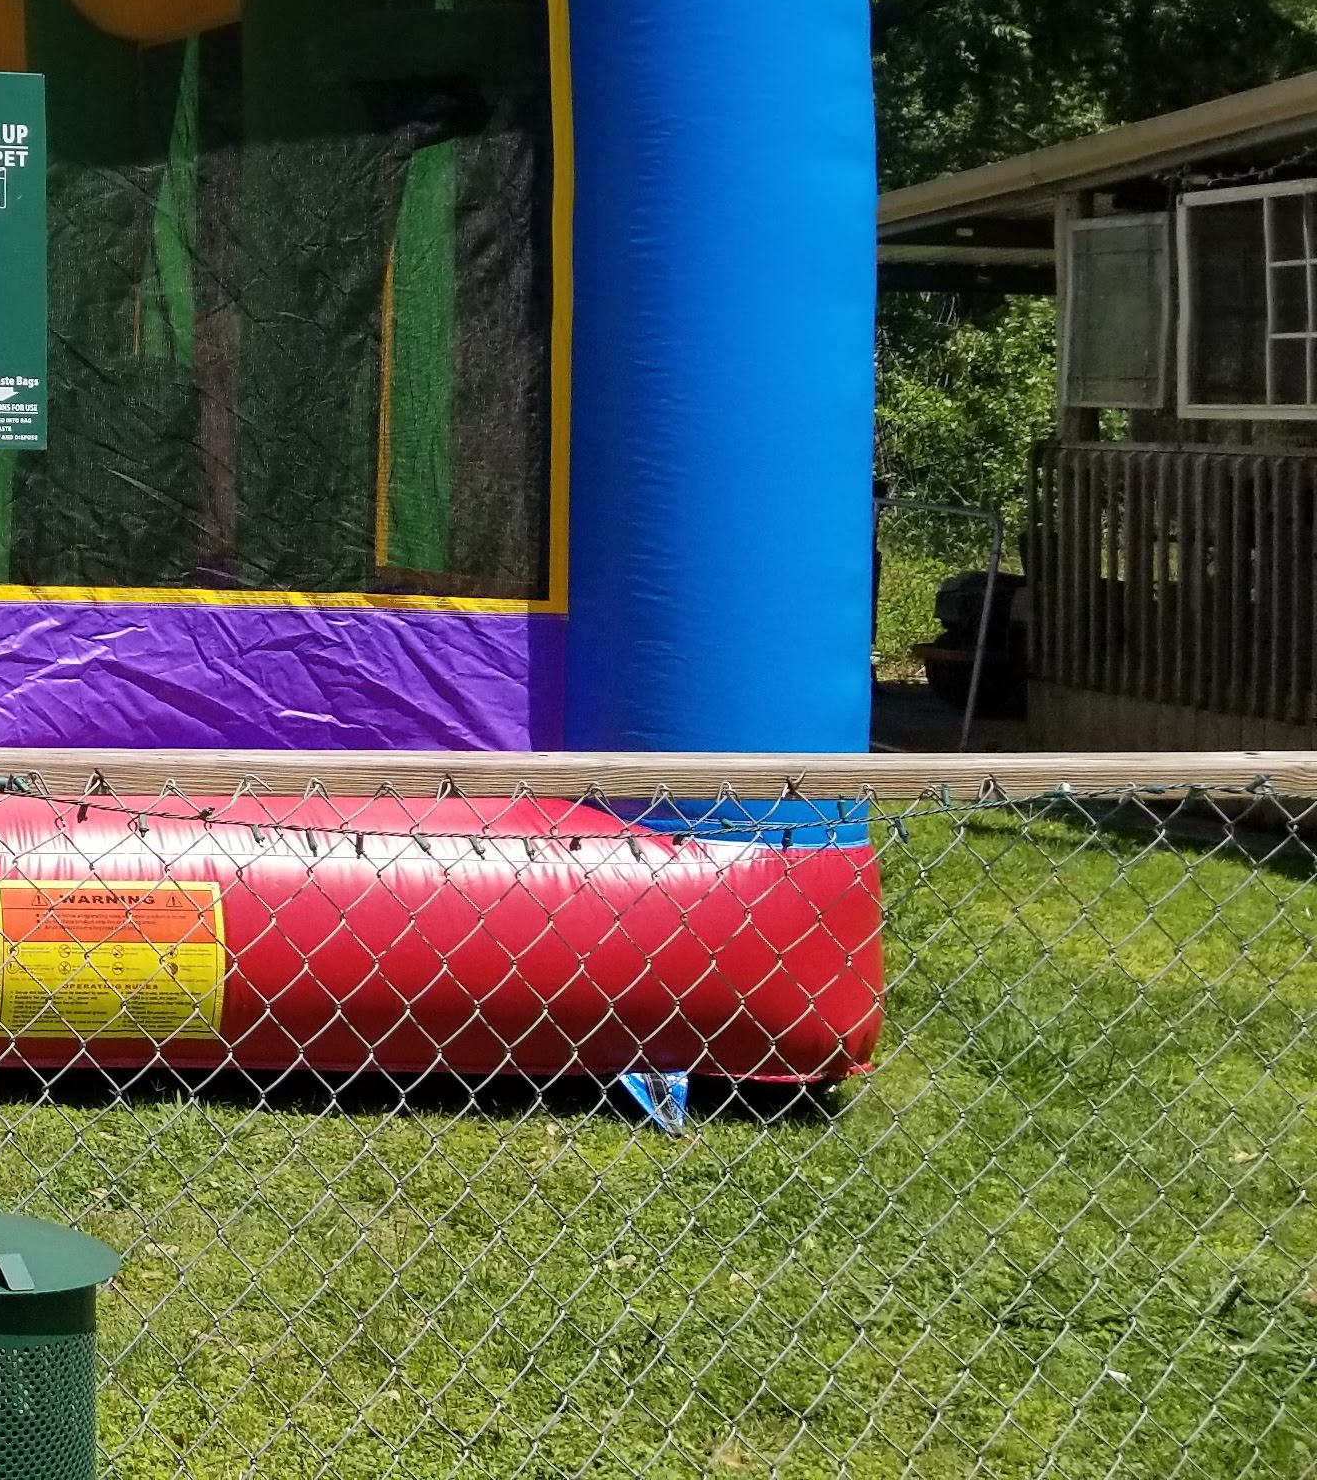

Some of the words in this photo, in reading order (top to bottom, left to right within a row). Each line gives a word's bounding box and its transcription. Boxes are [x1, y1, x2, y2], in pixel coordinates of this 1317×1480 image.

[2, 123, 28, 144] UP
[16, 376, 39, 388] Bags
[59, 894, 156, 905] WARNING
